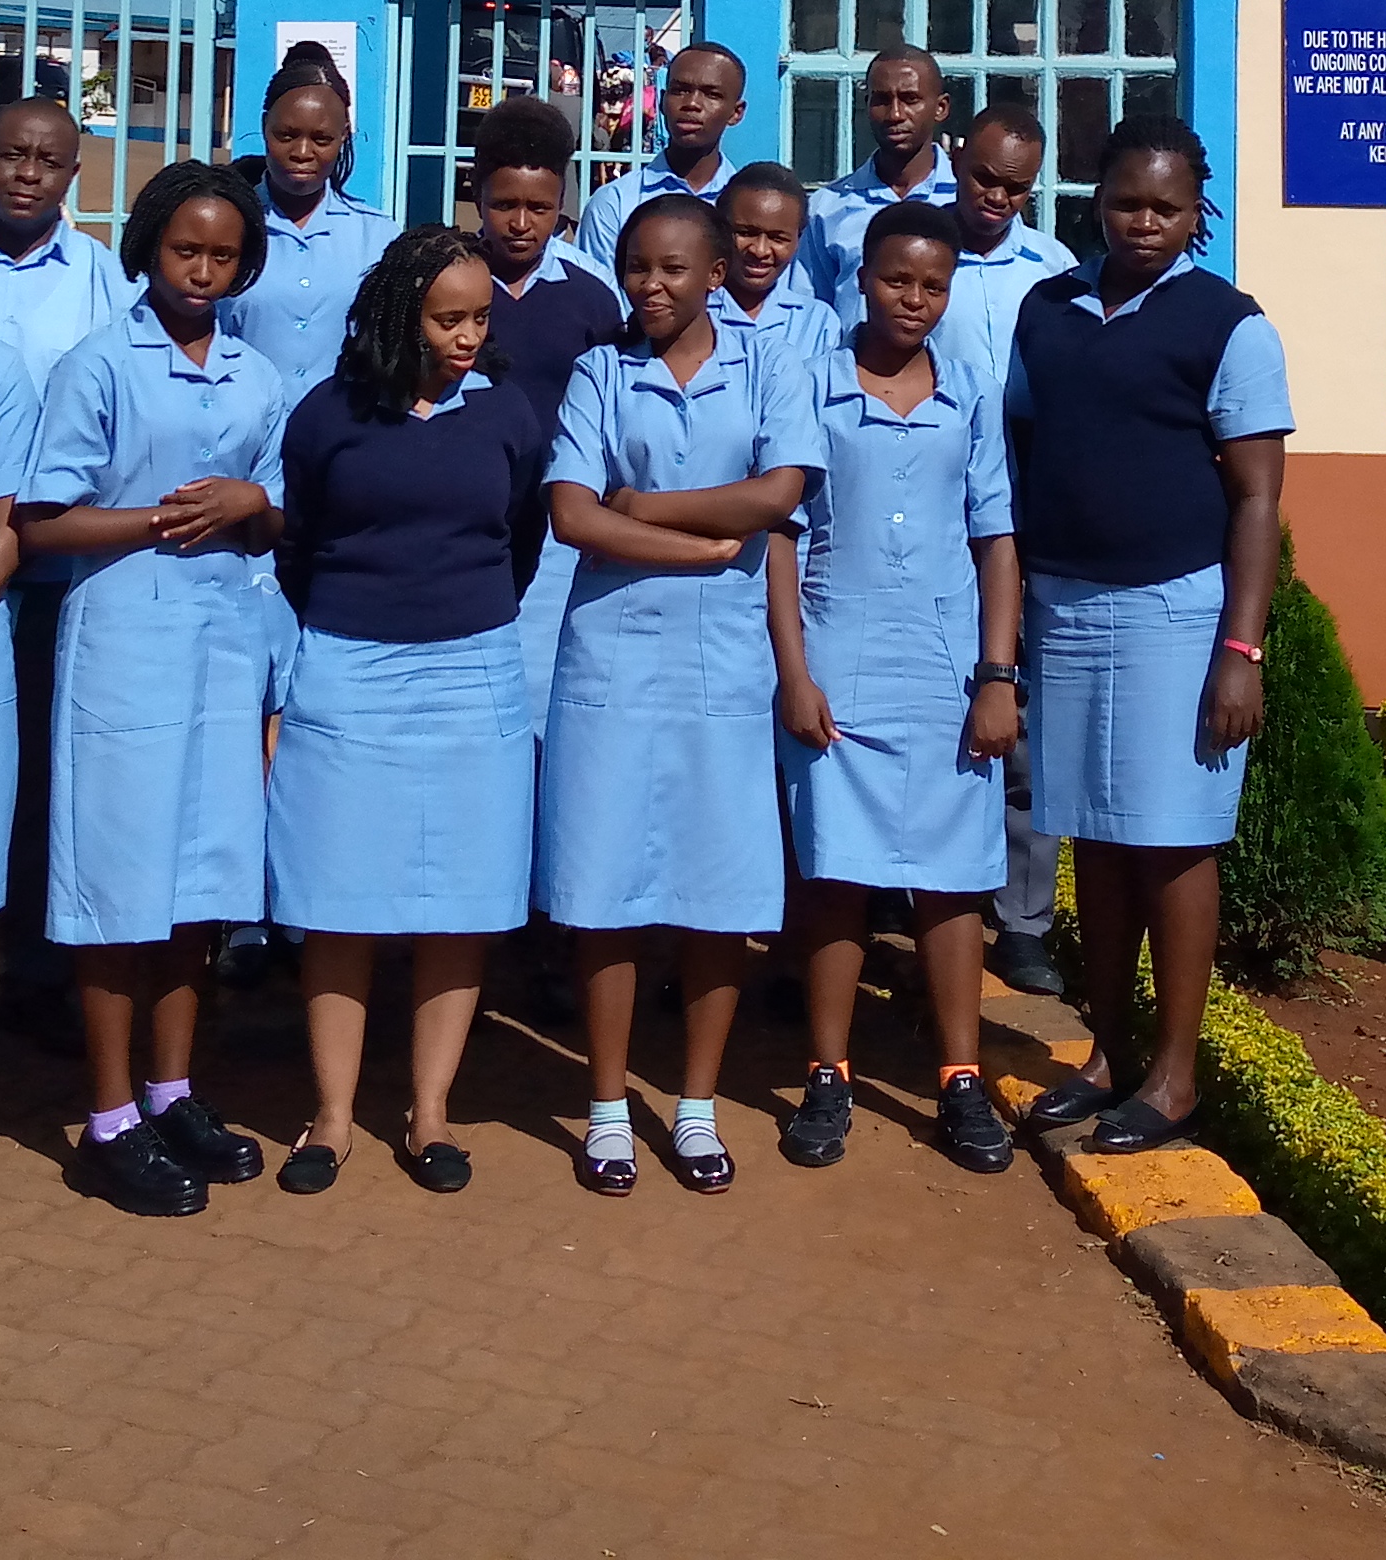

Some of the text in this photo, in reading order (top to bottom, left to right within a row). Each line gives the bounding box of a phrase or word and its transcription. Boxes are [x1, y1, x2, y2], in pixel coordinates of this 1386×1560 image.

[1304, 31, 1328, 48] DUE
[1331, 32, 1347, 48] TO
[1351, 32, 1375, 49] THE
[1311, 55, 1365, 72] ONGOING
[1295, 77, 1314, 94] WE
[1317, 78, 1341, 94] ARE
[1344, 78, 1369, 94] NOT
[1341, 123, 1355, 139] AT
[1359, 123, 1384, 139] ANY
